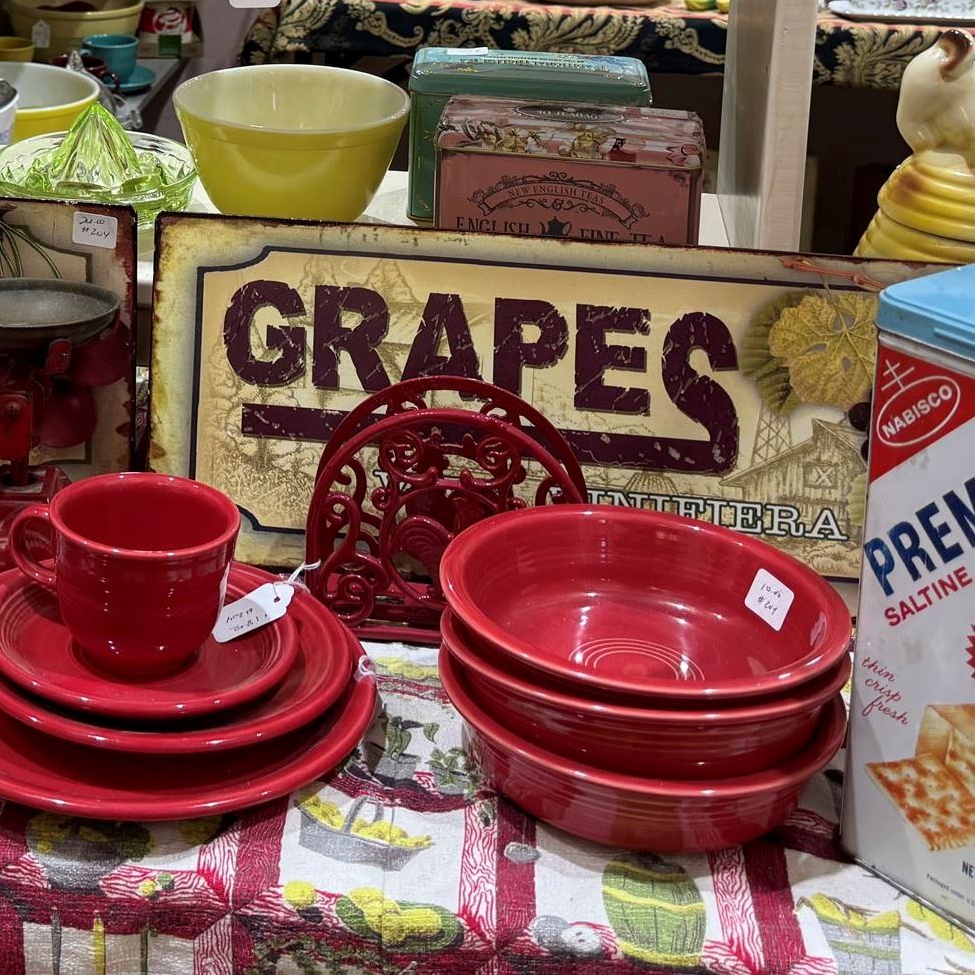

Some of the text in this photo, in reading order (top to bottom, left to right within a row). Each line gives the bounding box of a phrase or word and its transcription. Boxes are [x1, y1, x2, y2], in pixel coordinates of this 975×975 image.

[509, 185, 604, 204] NEW ENGLISH TEAS
[224, 279, 740, 475] GRAPES
[882, 383, 953, 439] NABISCO
[884, 566, 973, 627] SALTINE
[861, 656, 895, 683] thin
[865, 679, 903, 703] crisp
[862, 696, 909, 726] fresh
